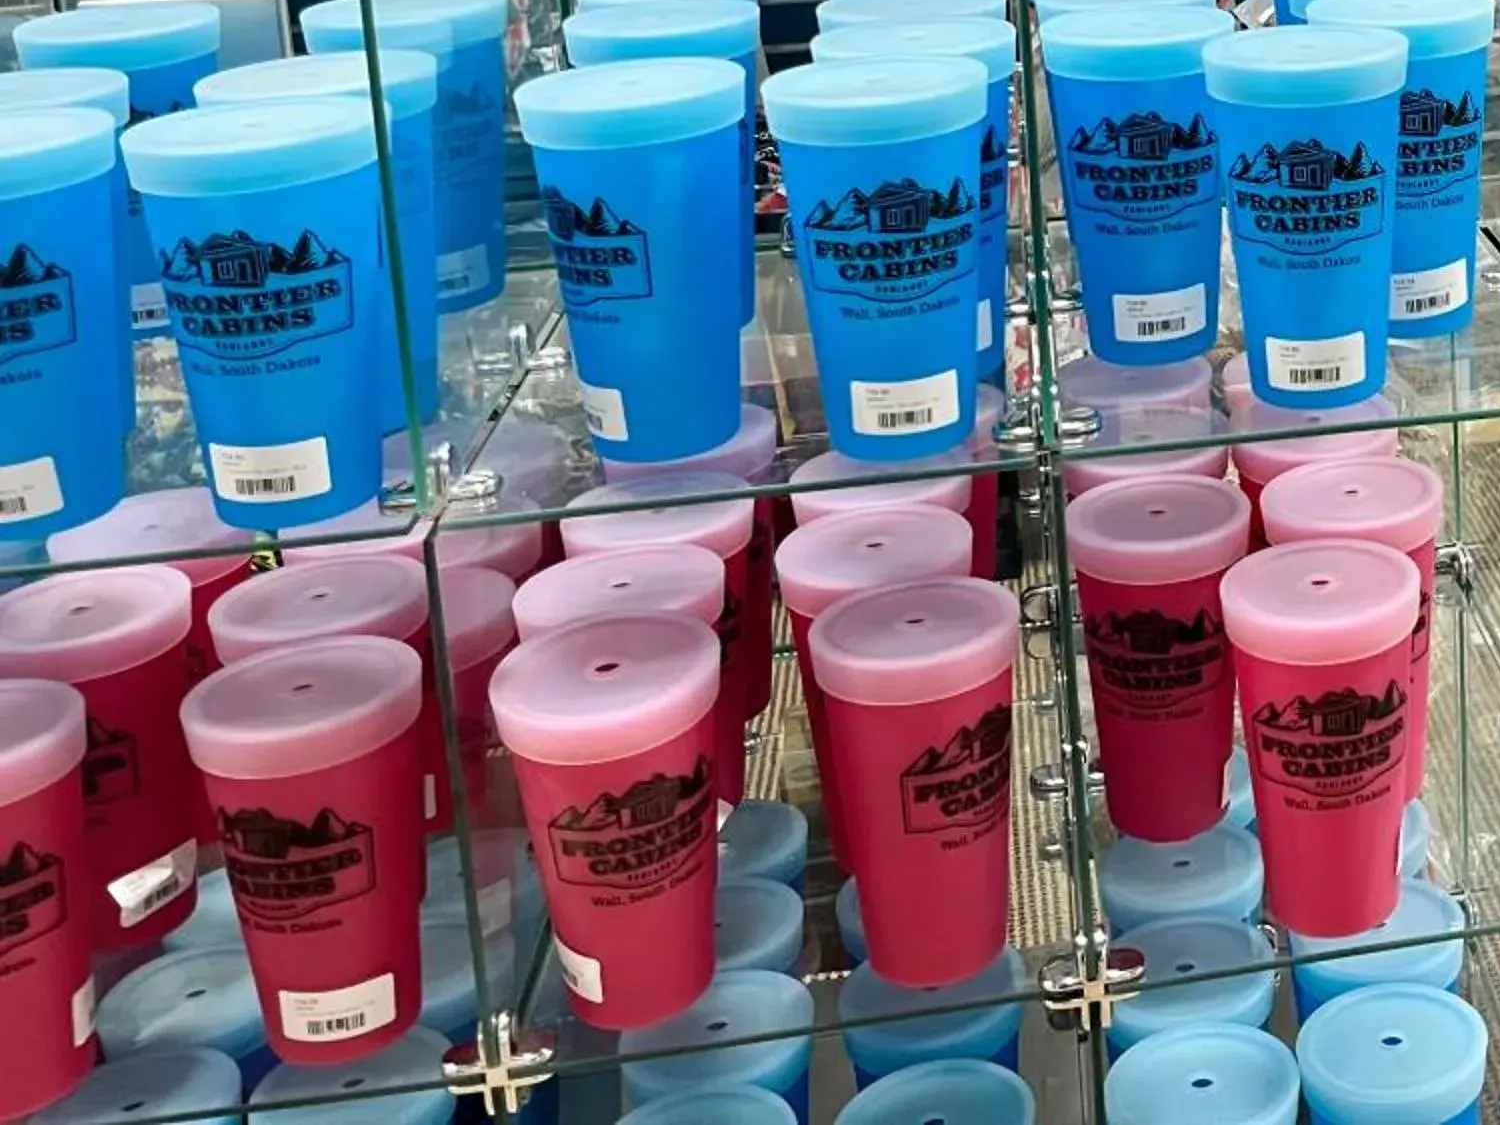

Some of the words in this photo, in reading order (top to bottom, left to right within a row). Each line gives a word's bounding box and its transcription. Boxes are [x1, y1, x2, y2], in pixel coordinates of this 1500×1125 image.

[1397, 130, 1478, 160] NTIER
[1074, 154, 1216, 184] FRONTIER
[1397, 154, 1466, 177] BINS
[1093, 178, 1199, 203] CABINS
[1235, 186, 1380, 214] FRONTIER
[1255, 210, 1362, 235] CABINS
[813, 223, 974, 261] FRONTIER
[838, 249, 959, 283] CABINS
[182, 306, 316, 338] CABINS
[0, 369, 43, 386] akota
[1260, 717, 1404, 760] FRONTIER
[1281, 743, 1392, 778] CABINS
[912, 759, 1009, 803] FRON
[588, 820, 704, 876] CABINS
[227, 847, 363, 882] ONTIER
